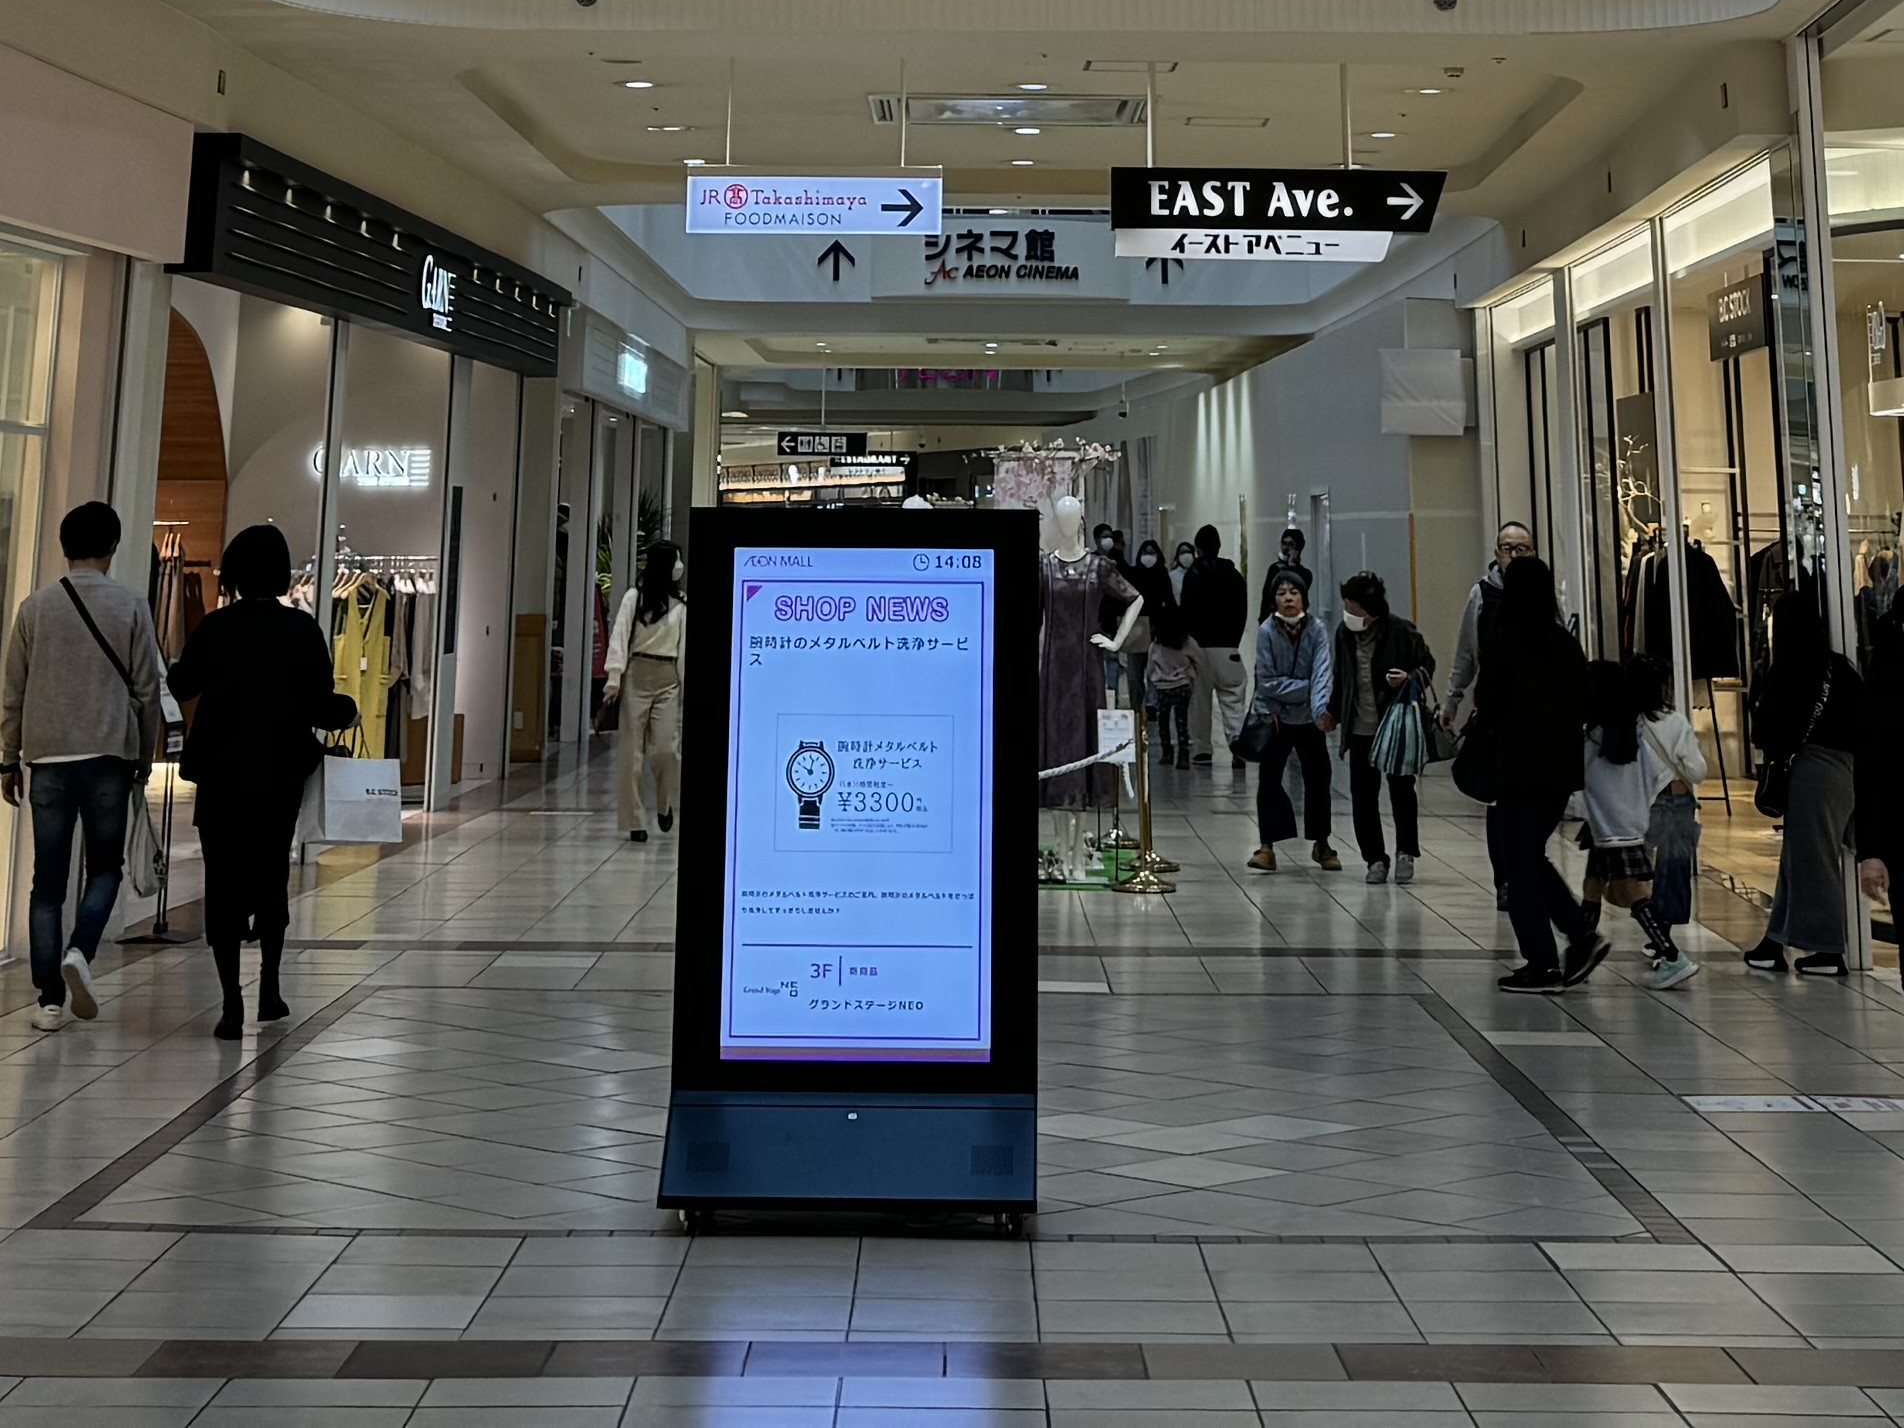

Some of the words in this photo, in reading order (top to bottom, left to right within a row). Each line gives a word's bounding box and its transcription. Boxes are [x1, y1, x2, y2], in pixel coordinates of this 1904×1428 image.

[700, 189, 721, 205] JR
[751, 190, 867, 210] Takashimaya
[1148, 180, 1251, 217] EAST
[1267, 181, 1354, 218] Ave.
[724, 212, 842, 226] FOODMAISON
[924, 229, 1055, 262] シネマ館
[1170, 233, 1339, 255] イーストアベニュー
[963, 264, 1011, 279] AEON
[1016, 264, 1079, 281] CINEMA
[780, 555, 813, 568] MALL
[935, 555, 982, 569] 14:08
[774, 595, 856, 622] SHOP
[865, 595, 949, 622] NEWS
[749, 652, 762, 666] ス
[837, 791, 914, 813] ¥3300
[810, 963, 833, 979] 3F
